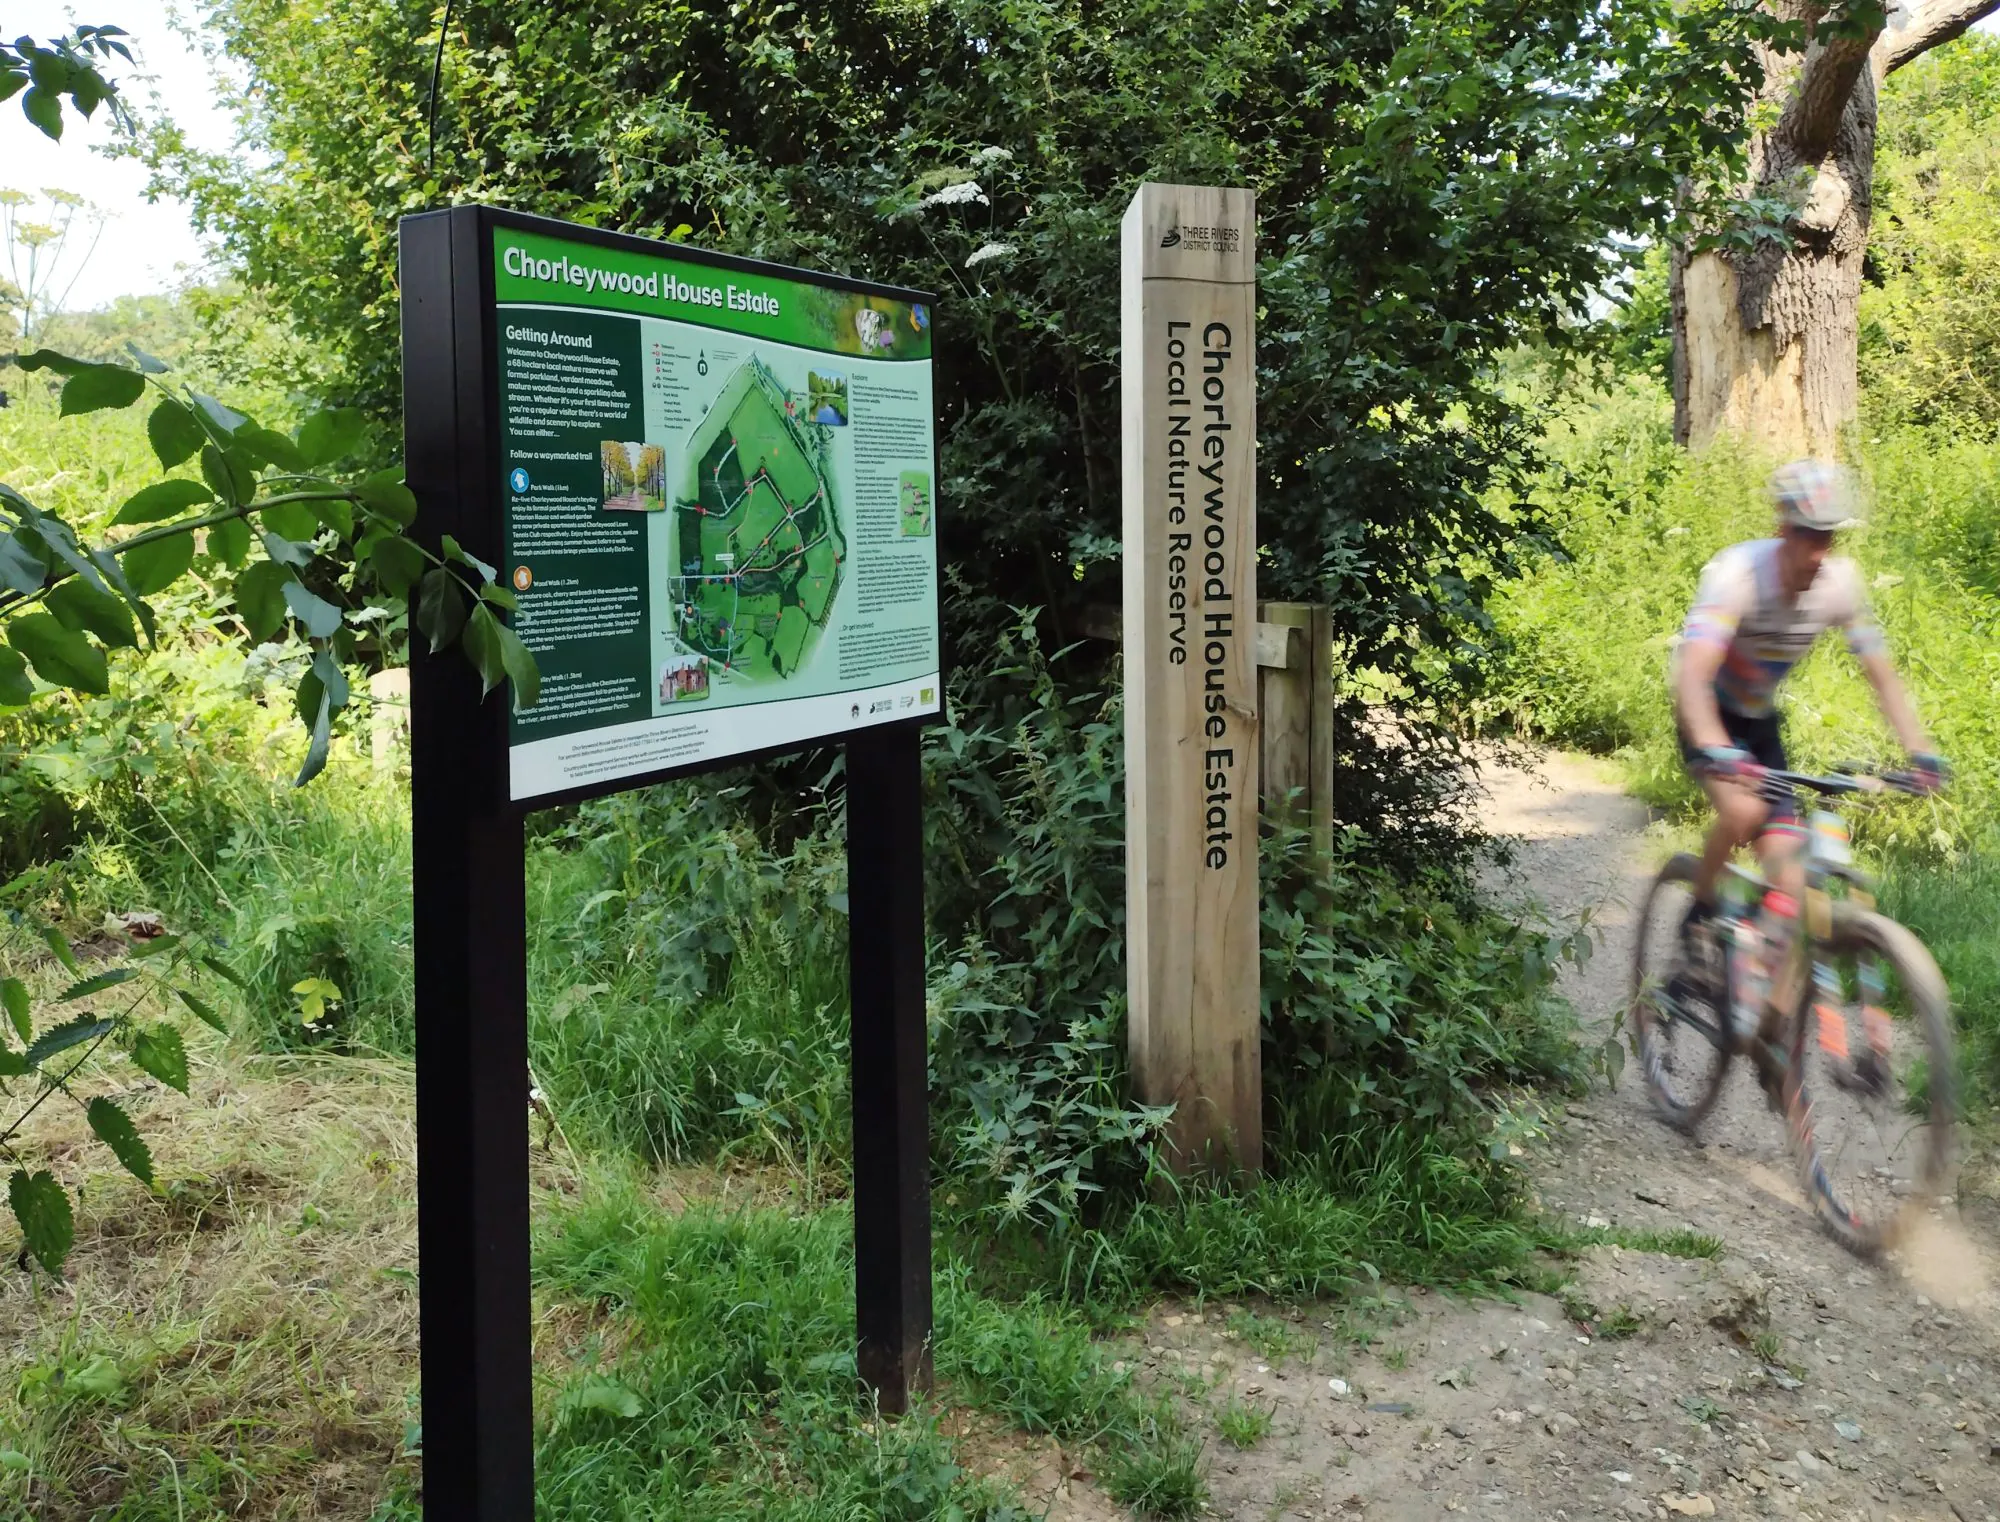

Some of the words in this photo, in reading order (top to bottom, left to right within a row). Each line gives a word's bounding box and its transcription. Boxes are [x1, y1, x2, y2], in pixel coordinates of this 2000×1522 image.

[1182, 226, 1209, 240] THREE
[1211, 227, 1239, 241] RIVERS
[1184, 240, 1211, 251] DISTRICT
[1213, 241, 1239, 253] COUNCIL
[504, 247, 658, 297] Chorleywood
[663, 273, 722, 307] House
[727, 284, 779, 315] Estate
[506, 325, 548, 346] Getting
[550, 331, 592, 348] Around
[506, 347, 537, 357] Welcome
[536, 350, 543, 358] to
[543, 350, 584, 362] Chorleywood
[584, 355, 602, 364] House
[602, 356, 620, 366] Estate,
[1168, 322, 1190, 406] Local
[512, 359, 521, 367] 68
[521, 360, 546, 369] hectare
[546, 362, 561, 370] local
[562, 365, 582, 373] nature
[582, 367, 605, 375] reserve
[507, 370, 529, 379] formal
[530, 372, 560, 382] parkland,
[584, 378, 614, 387] meadows,
[508, 382, 531, 390] mature
[532, 385, 566, 393] woodlands
[584, 388, 611, 398] sparkling
[611, 390, 626, 398] chalk
[508, 393, 533, 402] stream.
[533, 395, 560, 404] Whether
[585, 398, 596, 406] first
[610, 400, 624, 408] here
[536, 407, 558, 415] regular
[559, 408, 578, 416] visitor
[578, 409, 599, 417] there's
[509, 416, 533, 424] wildlife
[546, 419, 570, 428] scenery
[578, 420, 602, 429] explore.
[509, 427, 523, 435] You
[510, 450, 533, 458] Follow
[539, 452, 579, 460] waymarked
[579, 452, 593, 460] trail
[1201, 322, 1231, 602] Chorleywood
[1169, 416, 1191, 524] Nature
[1169, 534, 1191, 664] Reserve
[1204, 612, 1233, 739] House
[1206, 749, 1233, 870] Estate
